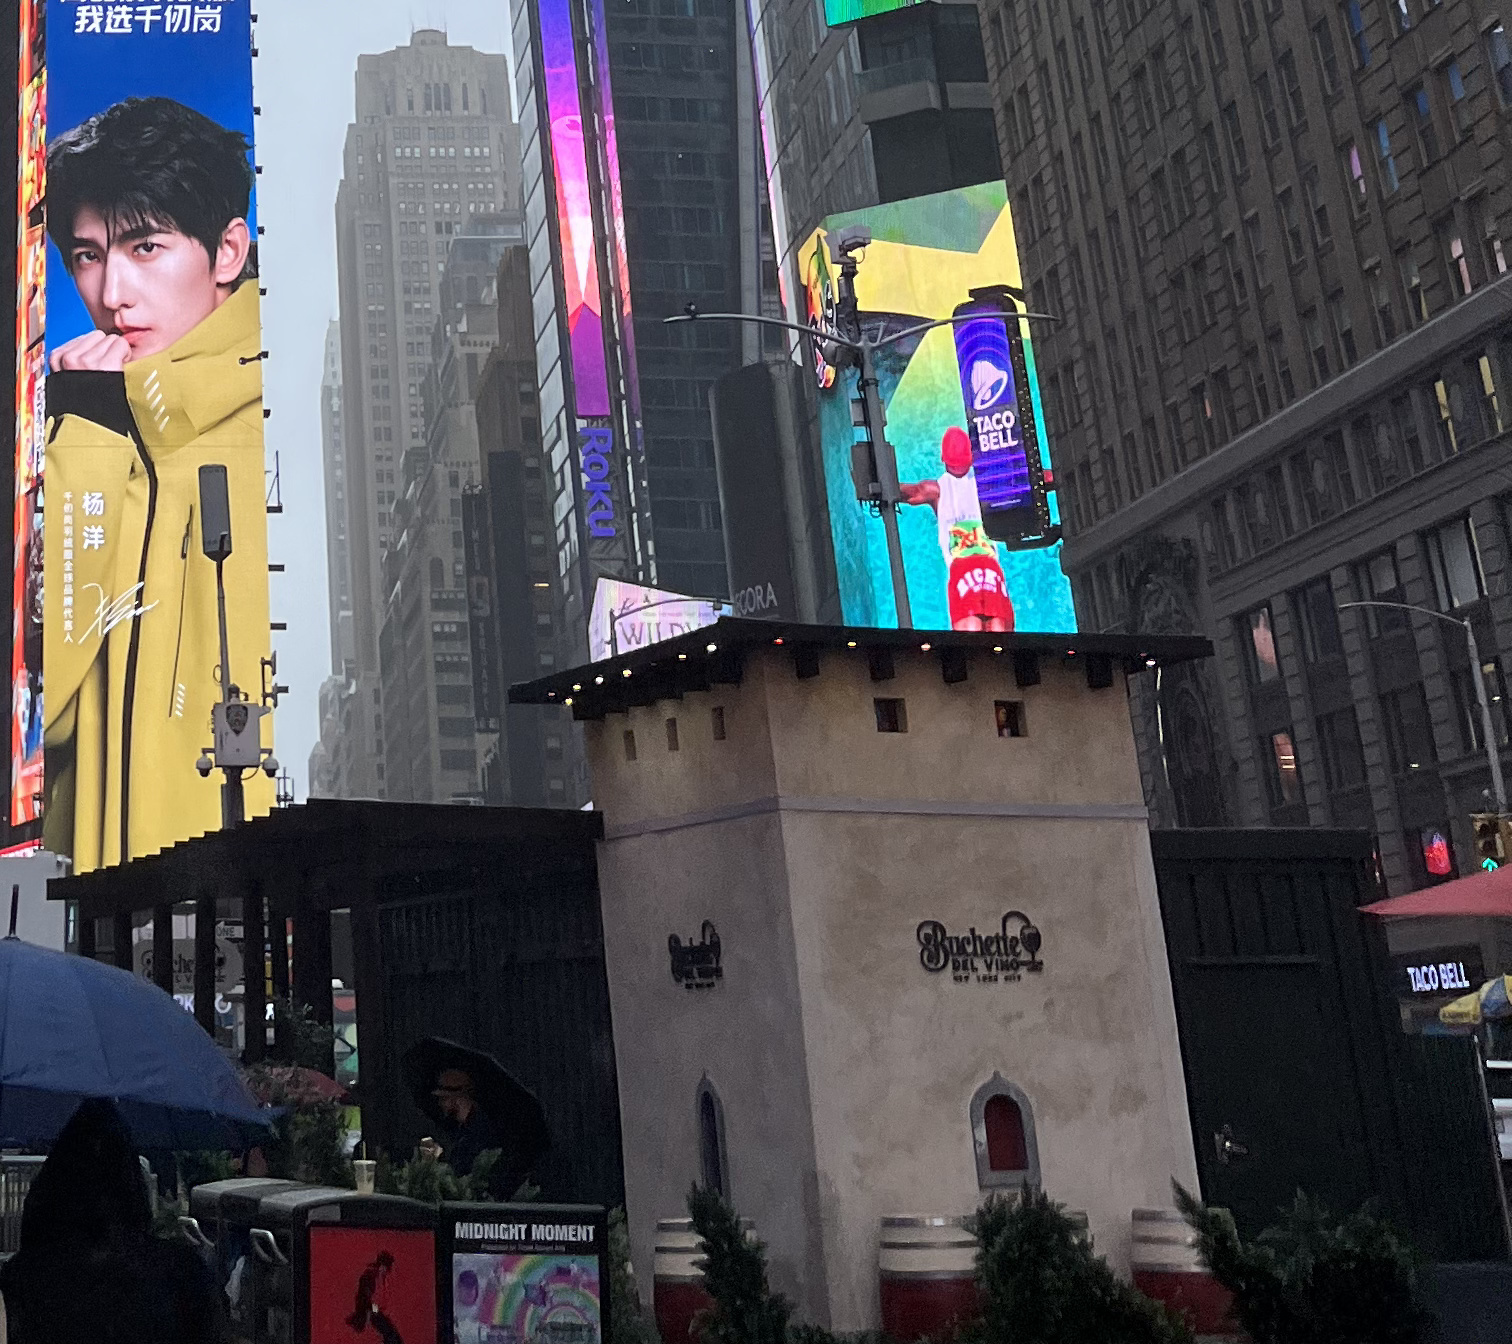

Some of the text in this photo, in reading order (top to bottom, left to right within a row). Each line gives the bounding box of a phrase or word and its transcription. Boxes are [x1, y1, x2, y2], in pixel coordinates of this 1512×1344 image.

[74, 4, 222, 33] 我选千仞岗
[973, 410, 1015, 434] TACO
[978, 428, 1019, 452] BELL
[82, 491, 105, 551] 杨洋
[952, 958, 1019, 972] DEL VINO
[1406, 961, 1470, 992] TACO BELL
[455, 1221, 595, 1242] MIDNIGHT MOMENT
